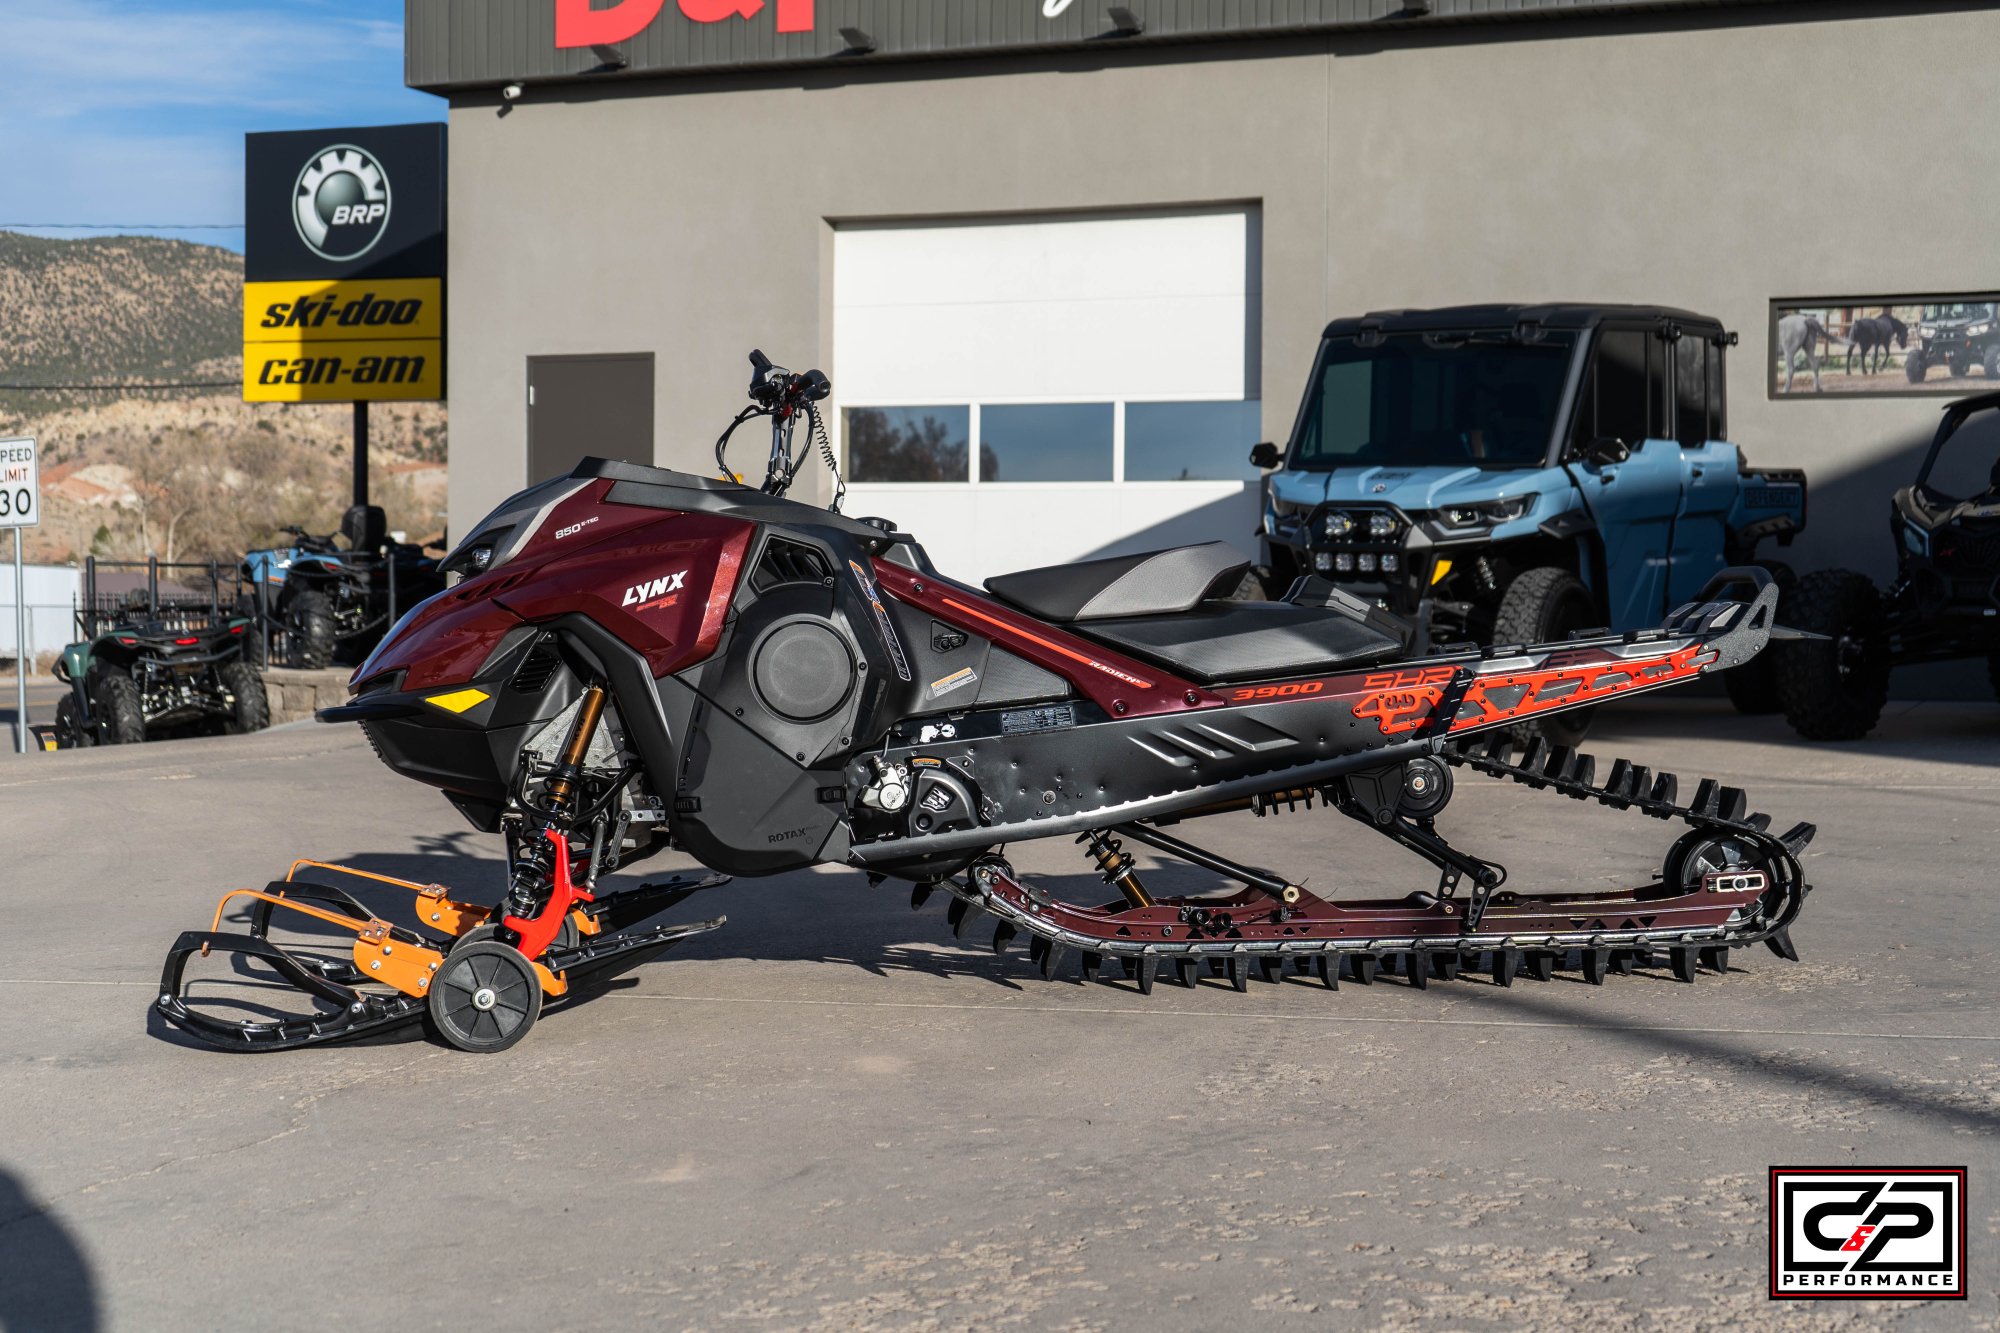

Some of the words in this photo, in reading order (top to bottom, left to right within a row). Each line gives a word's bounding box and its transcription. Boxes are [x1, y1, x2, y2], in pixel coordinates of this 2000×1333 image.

[332, 204, 385, 225] BRP
[260, 293, 423, 328] ski-doo
[258, 355, 426, 385] can-am
[0, 447, 32, 463] PEED
[0, 468, 28, 483] IMIT
[0, 488, 31, 516] 30
[555, 523, 581, 539] 850
[621, 569, 688, 608] LYNX
[1232, 681, 1324, 701] 3900
[768, 827, 807, 844] ROTAX
